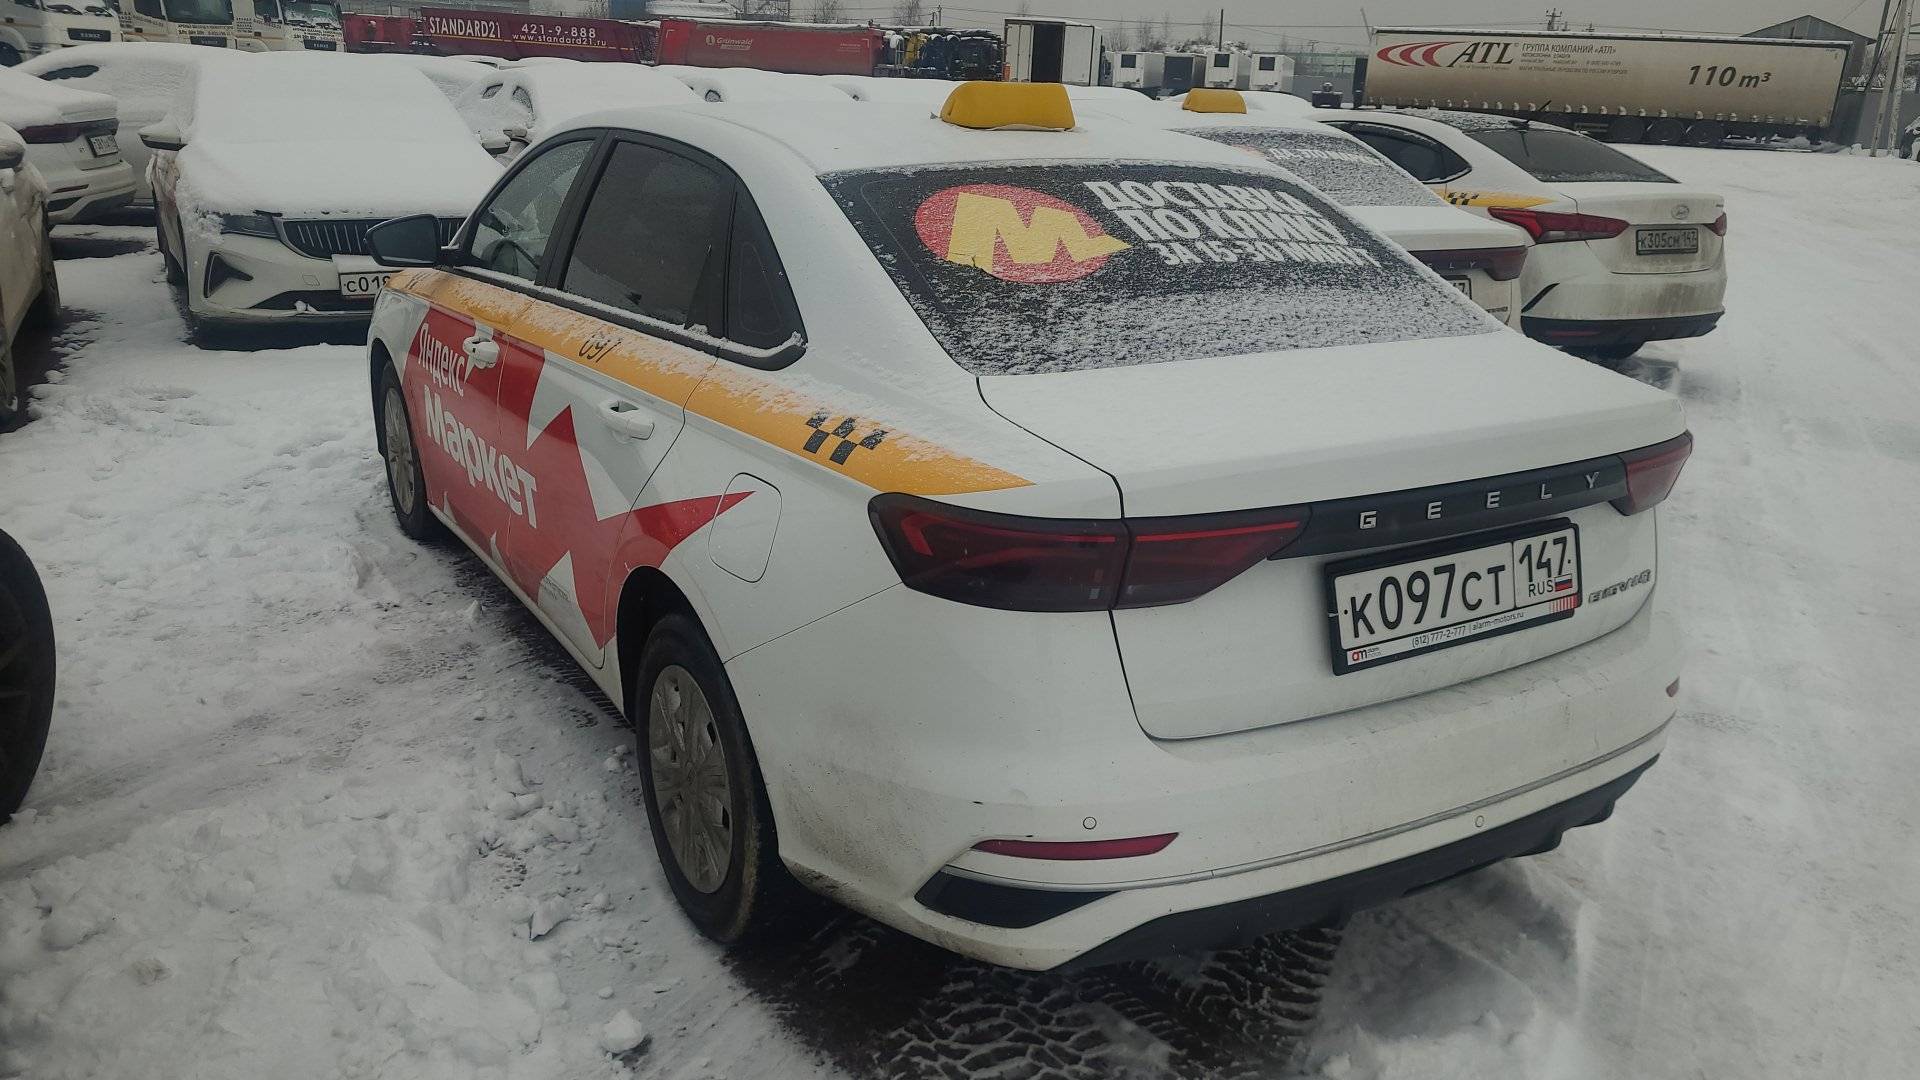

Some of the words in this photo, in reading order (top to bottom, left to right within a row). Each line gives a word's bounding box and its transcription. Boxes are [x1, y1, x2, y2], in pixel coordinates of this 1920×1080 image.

[429, 16, 501, 39] STANDARD21
[512, 34, 607, 46] www.standard21.ru
[521, 23, 596, 39] 421-9-888
[1446, 41, 1514, 68] ATL
[1522, 43, 1550, 53] ГРУППА
[1551, 44, 1594, 54] КОМПАНИЙ
[1689, 65, 1737, 87] 110
[1083, 180, 1323, 218] ДОСТАВКА
[1113, 209, 1202, 241] ПО
[1195, 210, 1349, 246] КЛИКУ
[1147, 242, 1202, 265] ЗА
[1195, 241, 1285, 263] 15-30
[1279, 242, 1383, 268] МИНУТ
[418, 322, 465, 397] Яндекс
[424, 384, 538, 529] Маркет
[1359, 471, 1600, 530] GEELY
[1350, 563, 1506, 639] К097СТ
[1518, 535, 1568, 583] 147
[1528, 578, 1555, 599] RUS
[1412, 635, 1430, 648] (812)
[1430, 625, 1466, 642] 777-2-777
[1472, 611, 1524, 631] alarm-motors.ru
